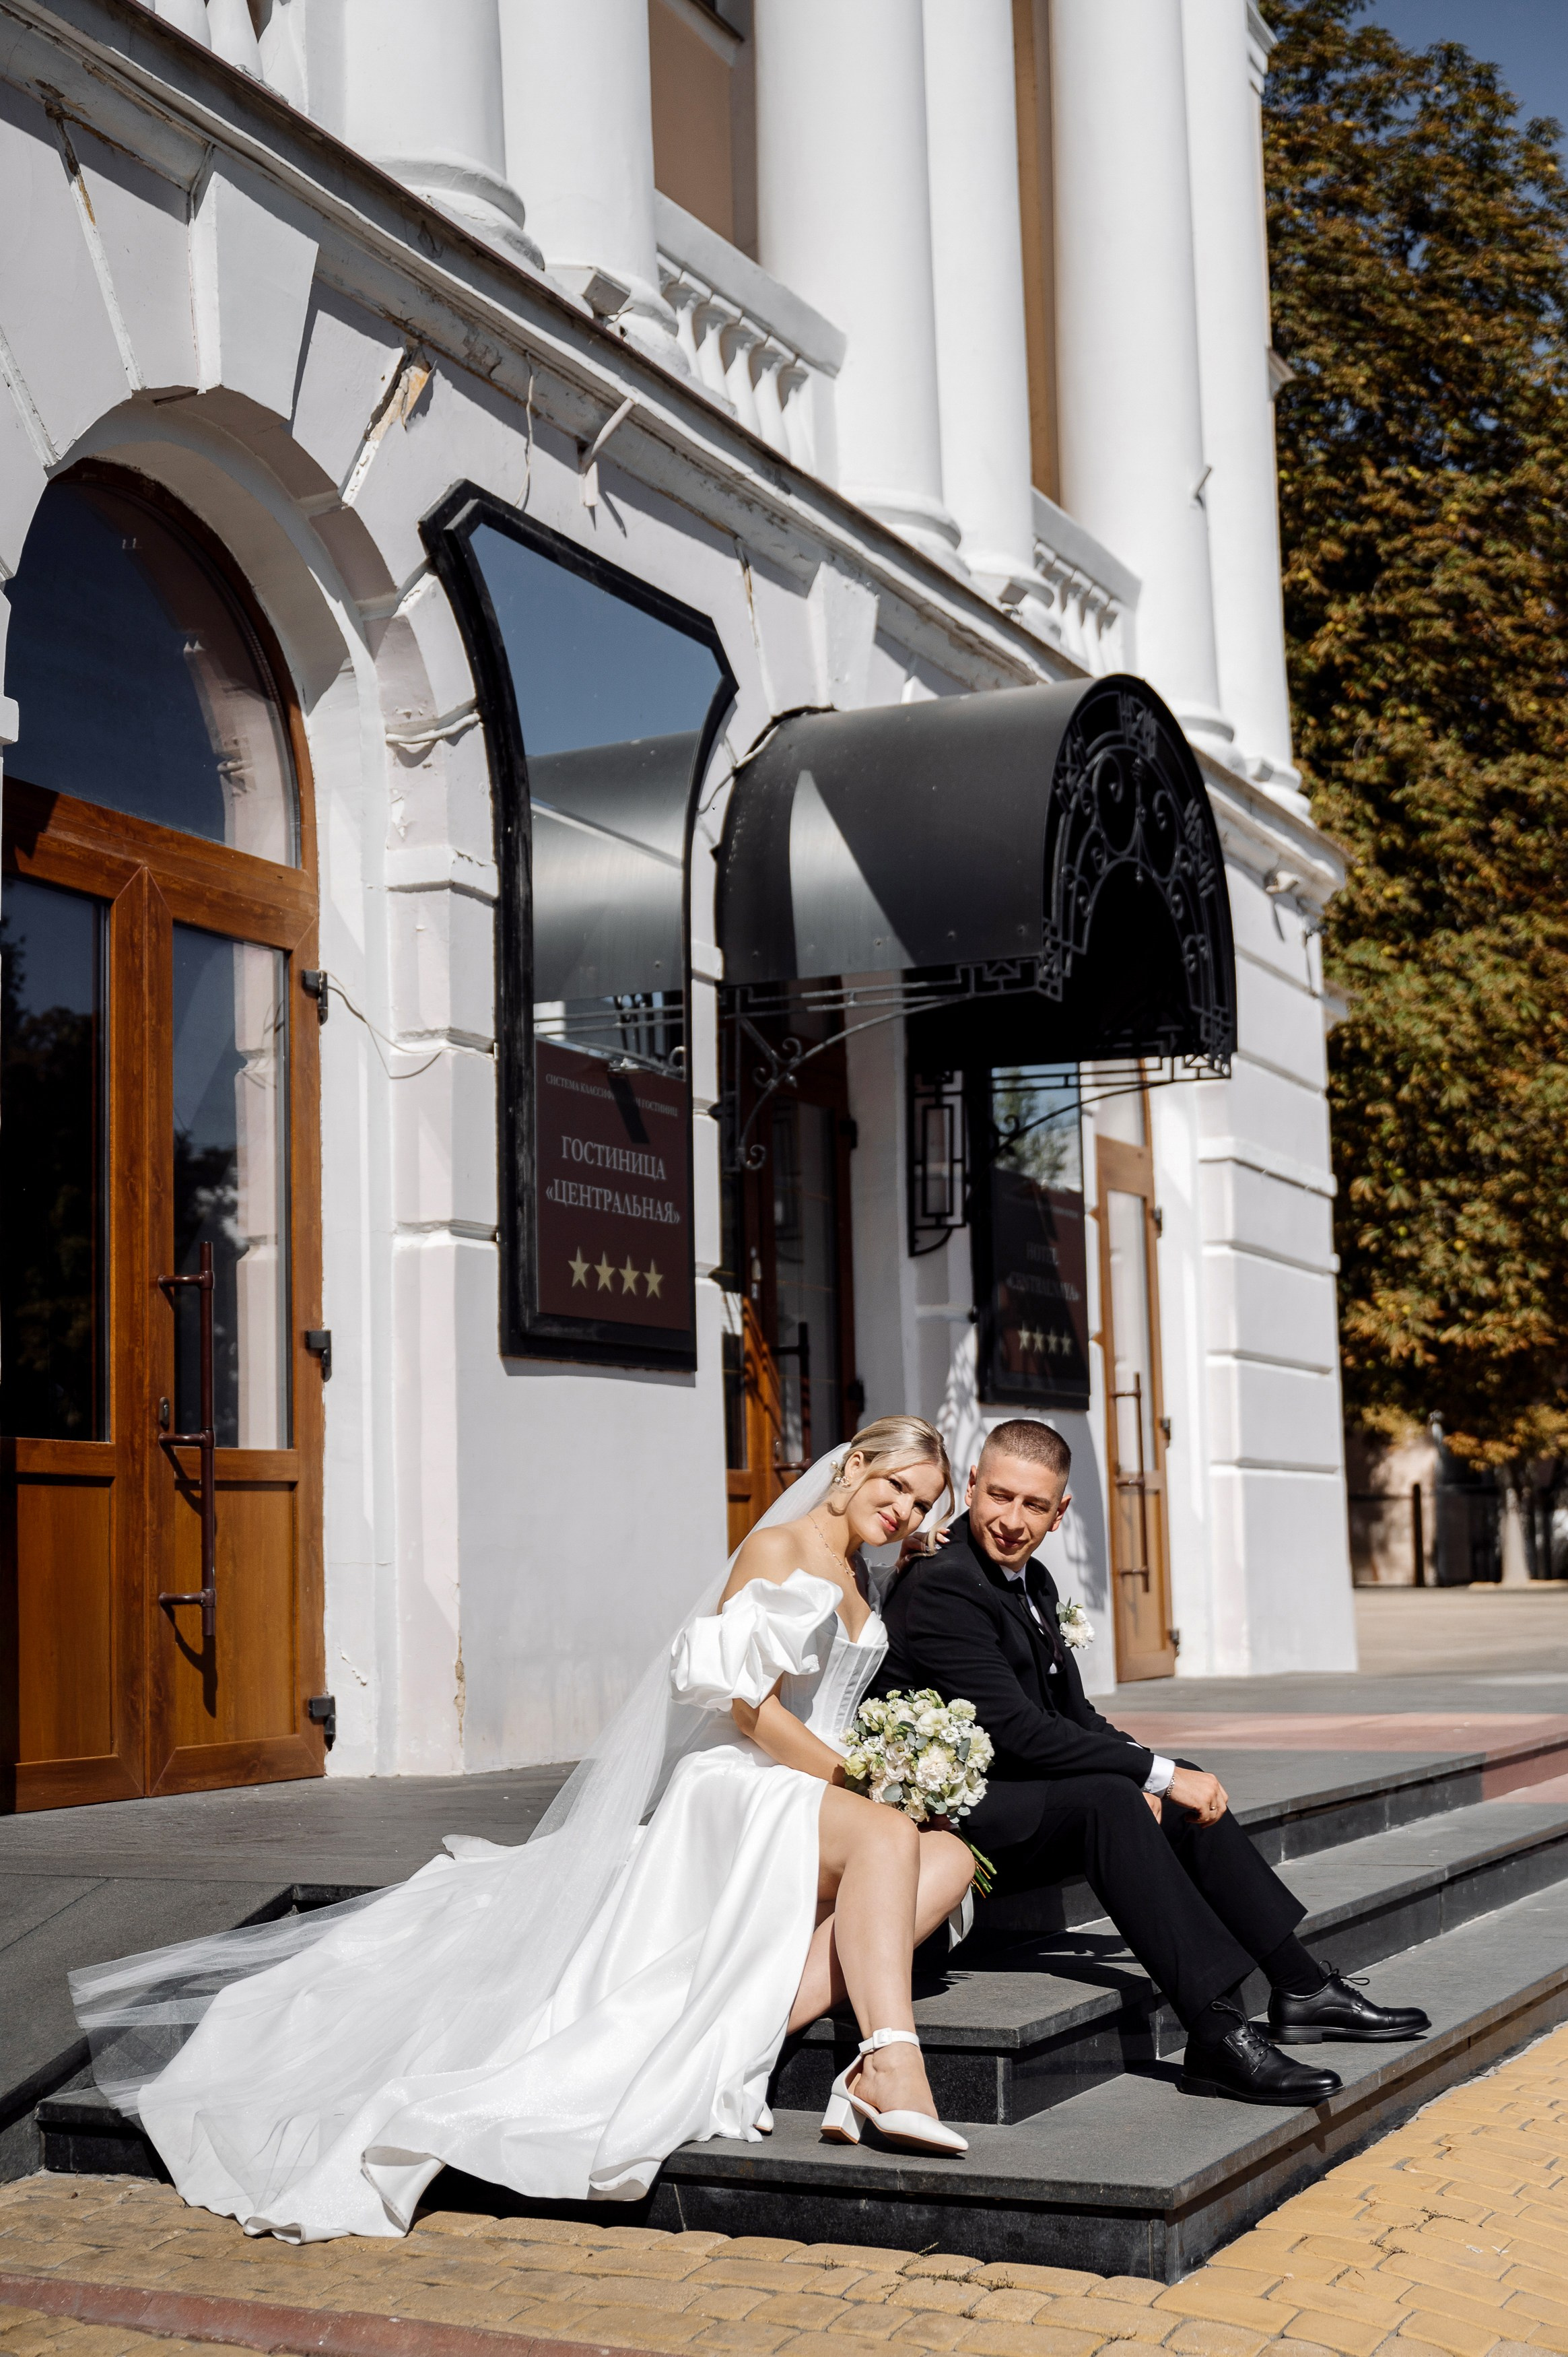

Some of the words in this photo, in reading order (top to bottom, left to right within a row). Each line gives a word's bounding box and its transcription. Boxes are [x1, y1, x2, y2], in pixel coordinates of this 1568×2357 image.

[545, 1073, 579, 1092] СИСТЕМА
[561, 1135, 667, 1181] ГОСТИНИЦА
[546, 1178, 681, 1224] «ЦЕНТРАЛЬНАЯ»
